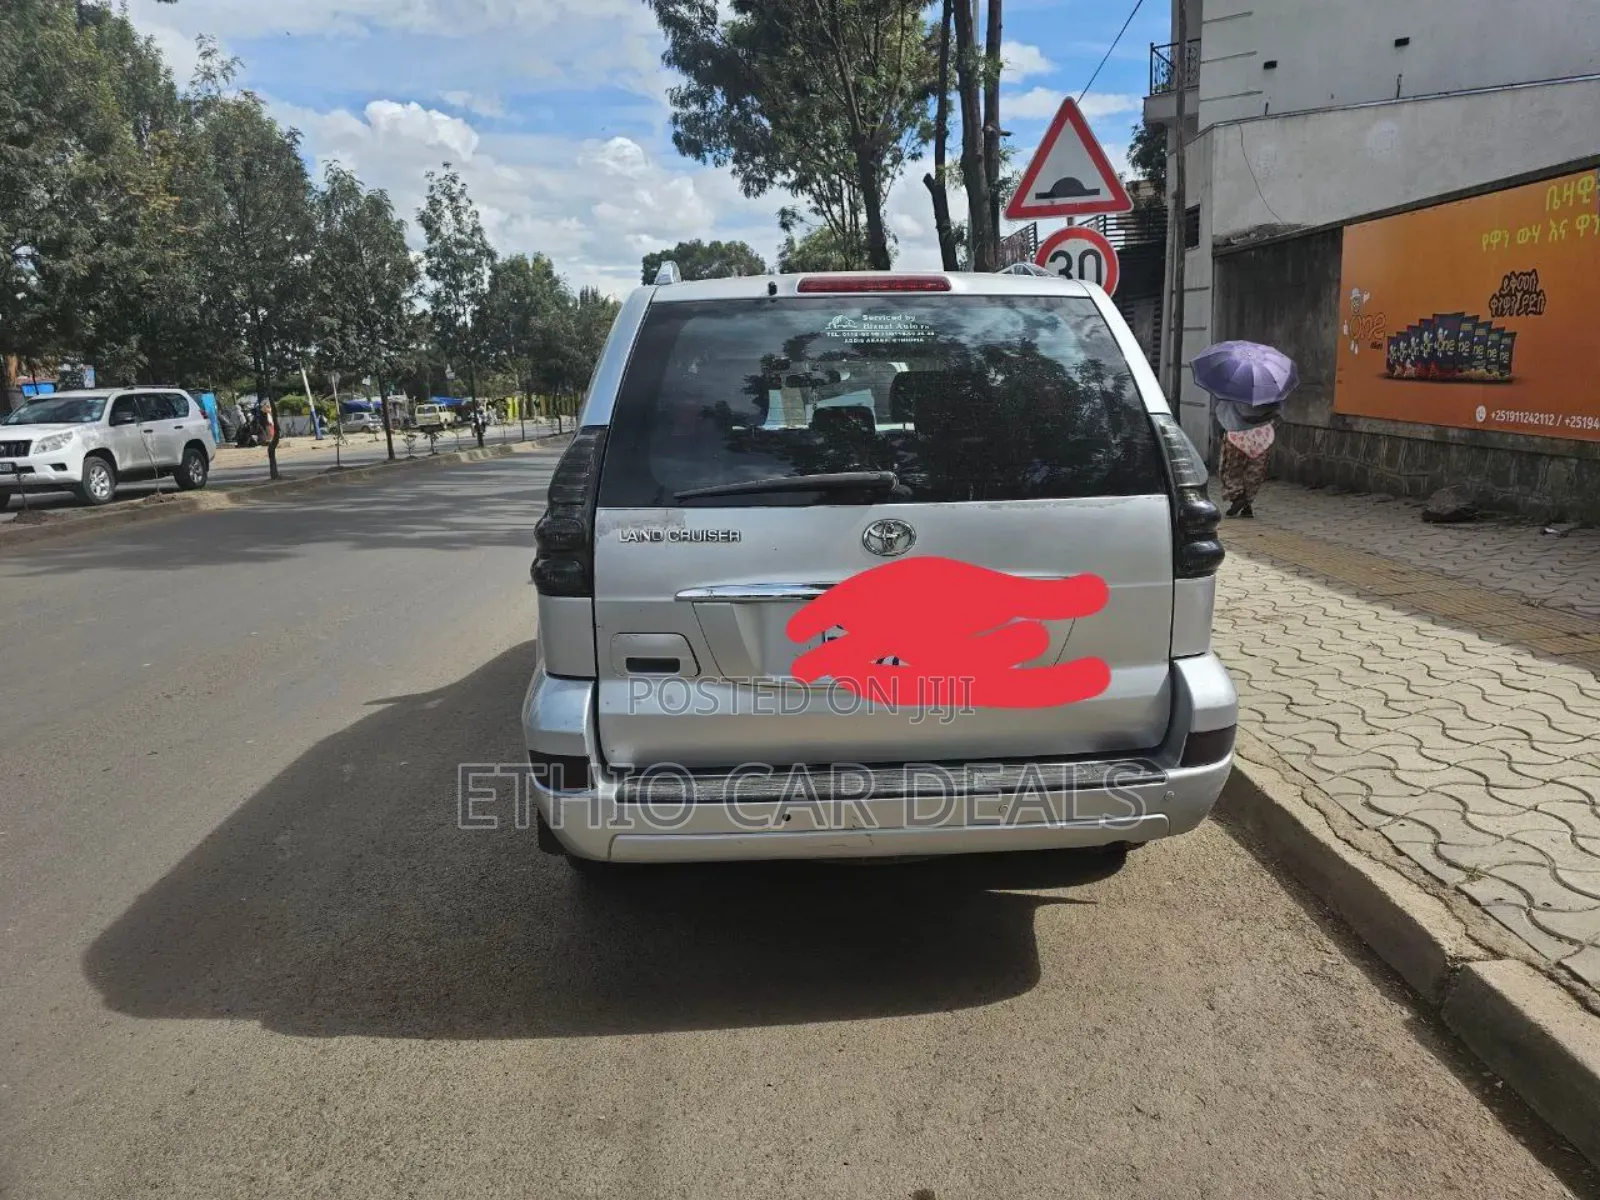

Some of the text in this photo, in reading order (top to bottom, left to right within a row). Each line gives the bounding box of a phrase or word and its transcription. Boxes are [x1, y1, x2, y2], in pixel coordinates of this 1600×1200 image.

[1049, 248, 1102, 287] 30
[905, 314, 916, 322] by
[1491, 409, 1556, 427] +251911242112
[619, 529, 741, 543] LAND CRUISER
